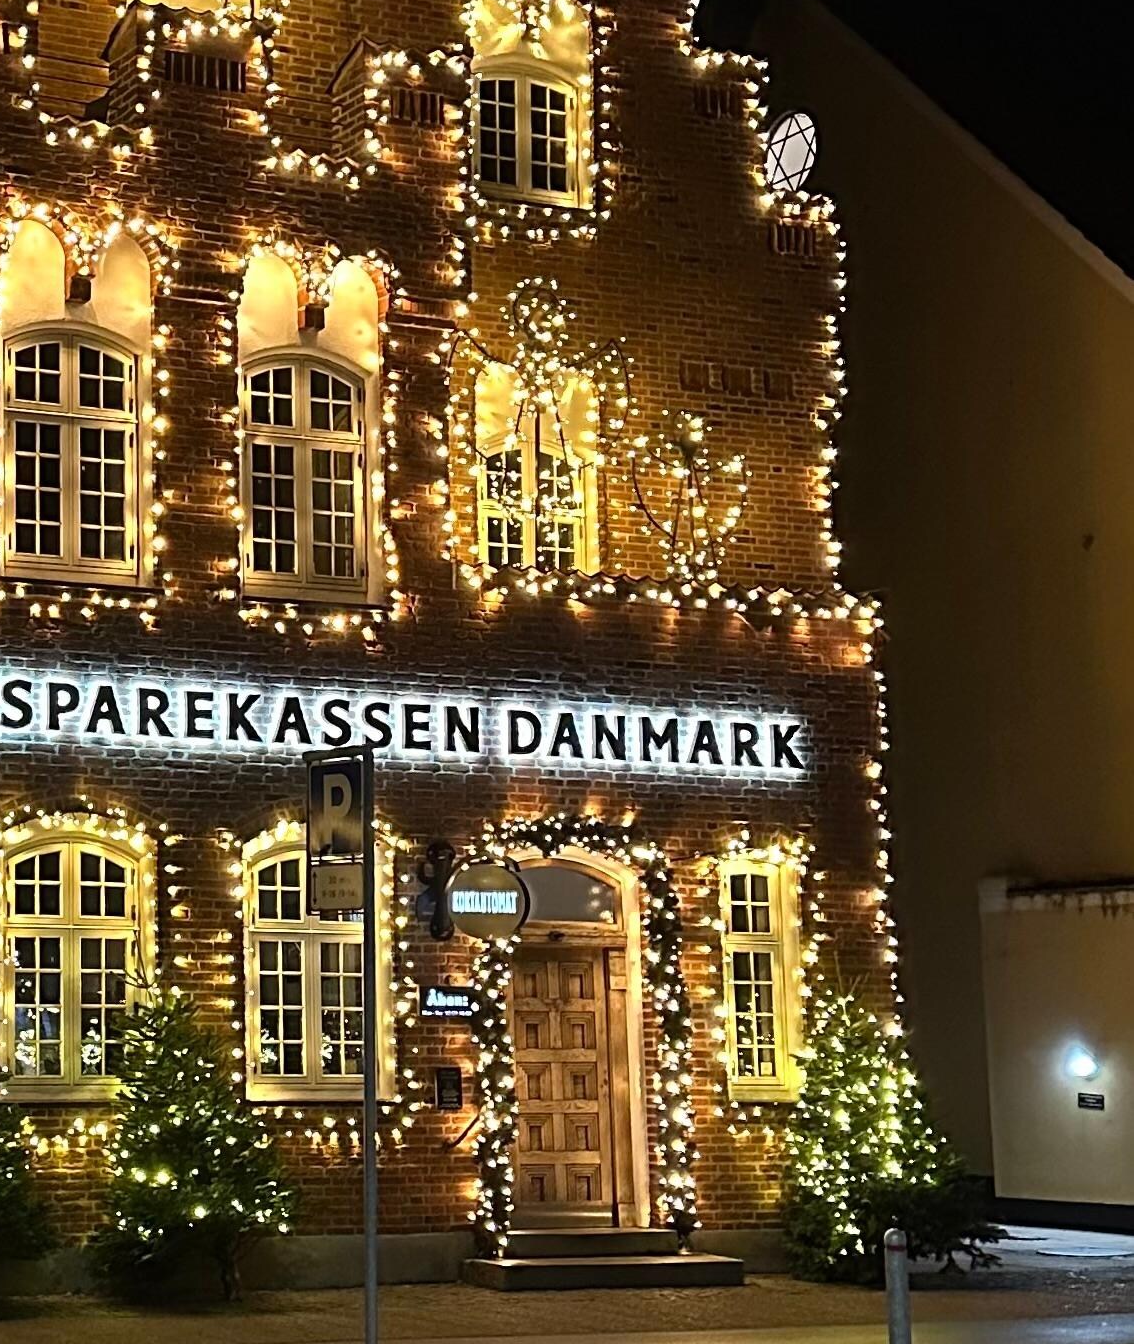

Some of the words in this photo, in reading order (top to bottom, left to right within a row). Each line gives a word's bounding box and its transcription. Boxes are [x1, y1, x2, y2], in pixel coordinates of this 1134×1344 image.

[0, 679, 480, 753] SPAREKASSEN
[507, 709, 806, 770] DANMARK
[322, 772, 353, 853] P
